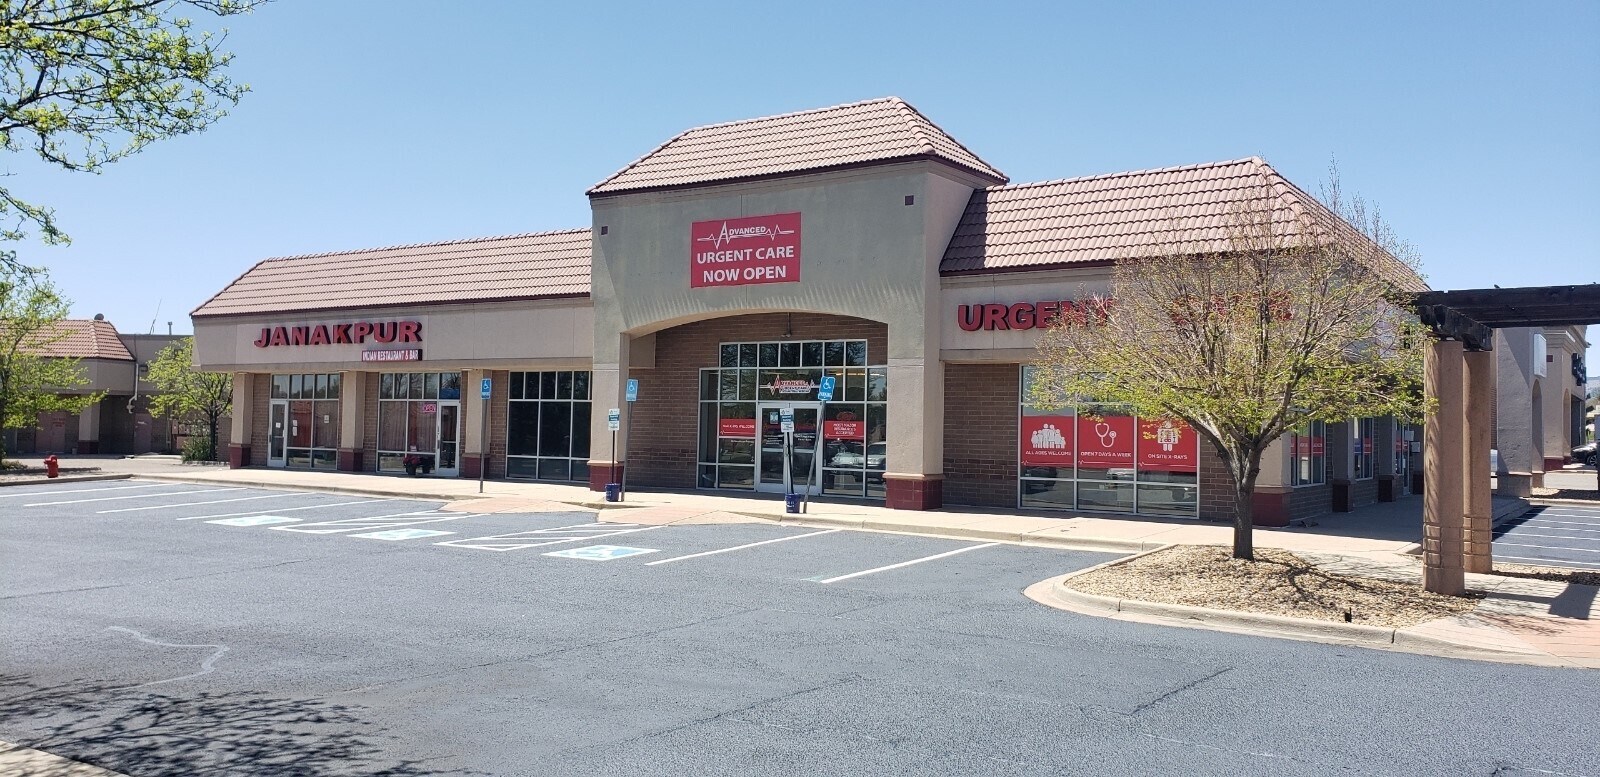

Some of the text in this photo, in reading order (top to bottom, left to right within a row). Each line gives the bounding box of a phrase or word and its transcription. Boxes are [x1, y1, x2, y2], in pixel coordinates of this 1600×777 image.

[697, 245, 795, 264] URGENT CARE
[703, 265, 787, 283] NOW OPEN
[253, 320, 423, 348] JANAKPUR
[377, 350, 404, 361] RESTAURANT
[409, 349, 419, 360] BAR
